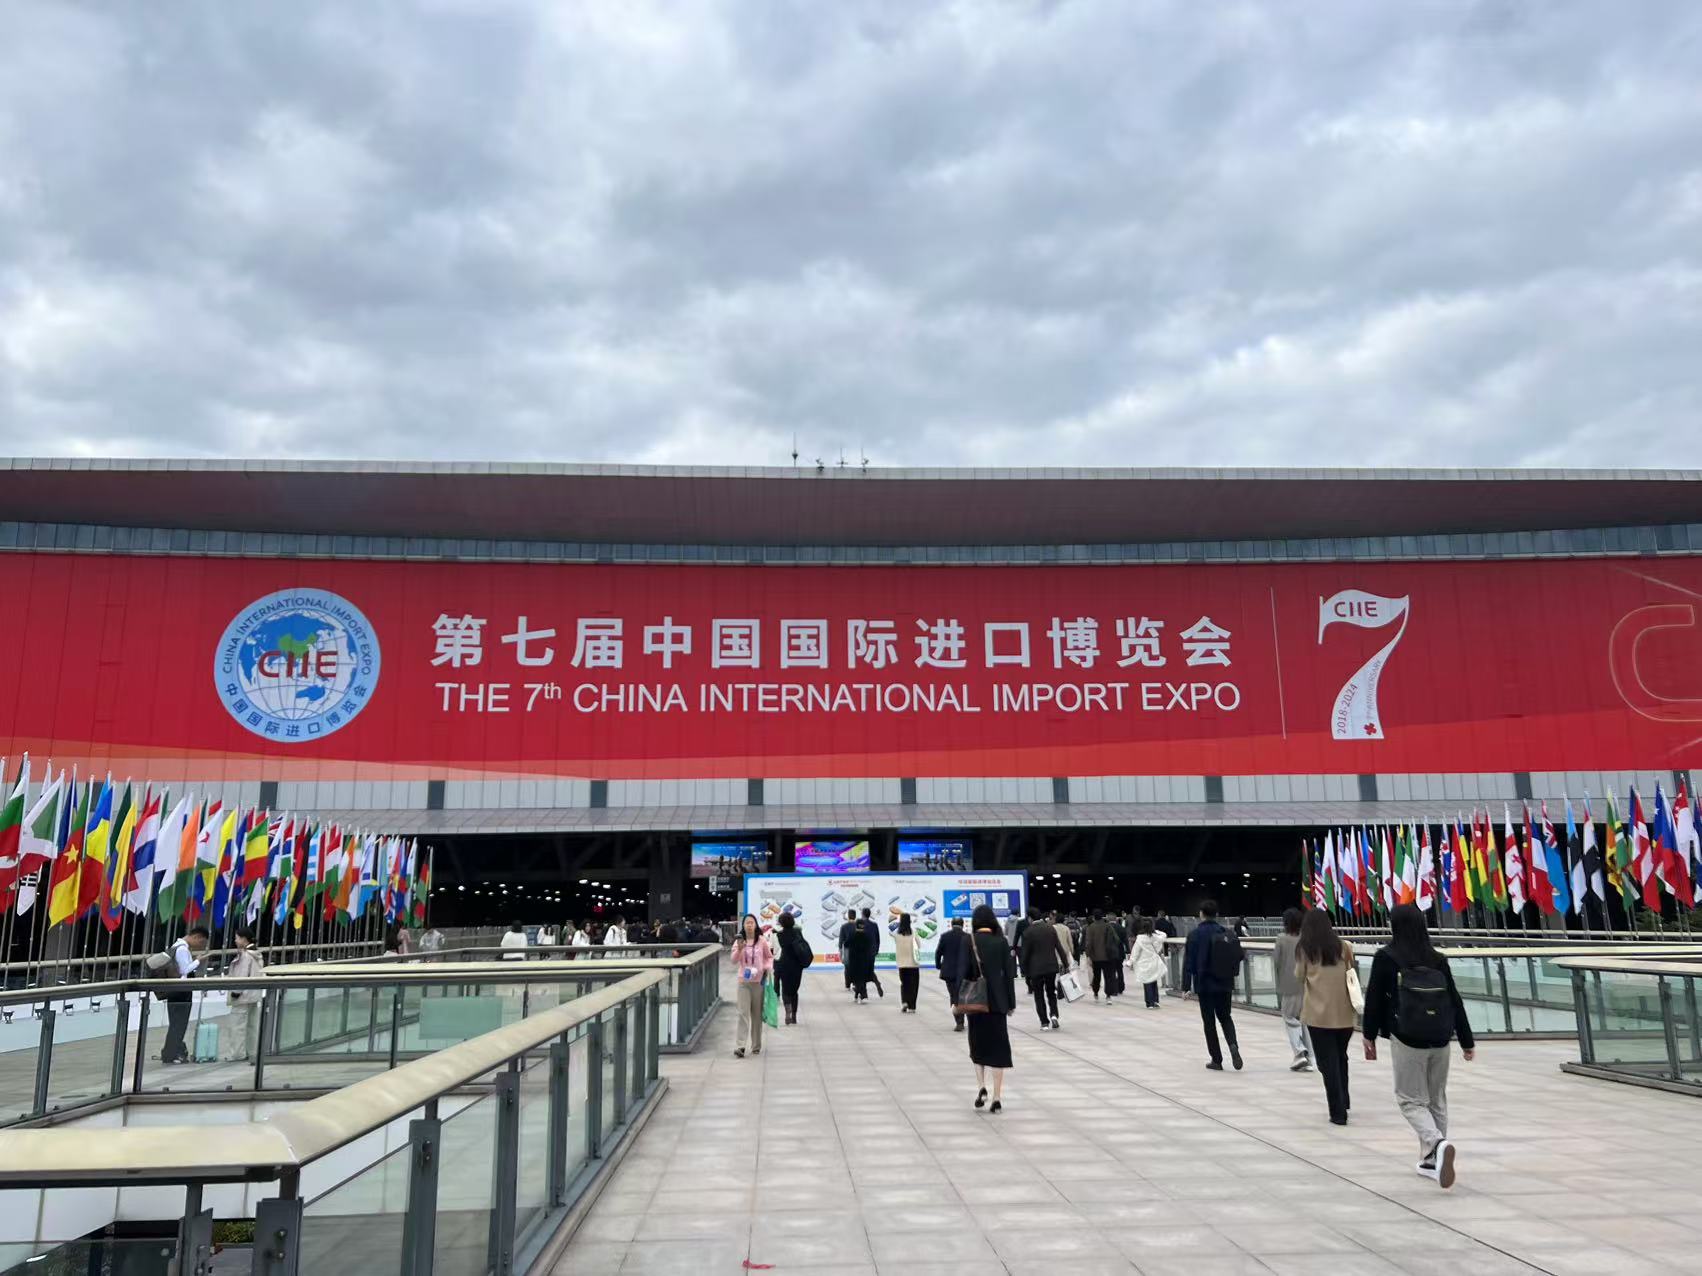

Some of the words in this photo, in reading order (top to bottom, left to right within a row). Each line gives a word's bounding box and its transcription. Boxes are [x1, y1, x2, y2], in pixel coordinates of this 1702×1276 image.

[1334, 601, 1378, 617] CIIE
[222, 637, 239, 674] CHINA
[236, 597, 329, 635] INTERNATIONAL
[331, 606, 366, 640] IMPORT
[360, 642, 373, 675] EXPO
[430, 613, 1232, 669] 第七届中国国际进口博览会
[258, 650, 339, 679] CIIE
[225, 683, 368, 737] 中国国际进口博览会
[435, 682, 510, 713] THE
[523, 682, 562, 712] 7th
[573, 683, 688, 713] CHINA
[700, 683, 981, 712] INTERNATIONAL
[993, 682, 1129, 712] IMPORT
[1141, 682, 1241, 712] EXPO
[1337, 682, 1358, 734] 2018-2024
